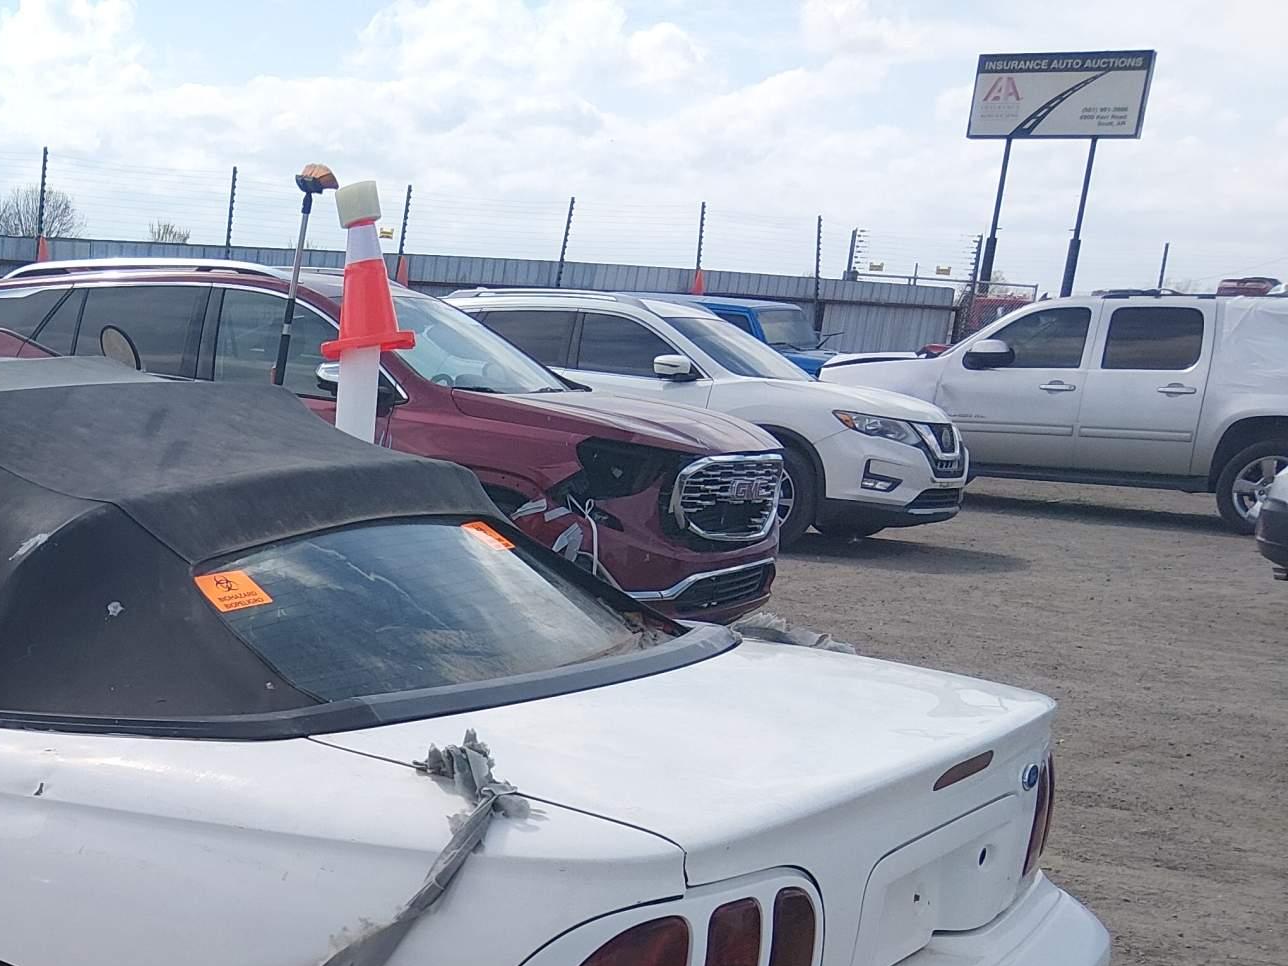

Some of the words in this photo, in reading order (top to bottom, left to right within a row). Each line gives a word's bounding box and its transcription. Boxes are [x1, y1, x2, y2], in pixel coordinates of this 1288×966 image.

[984, 59, 1049, 71] INSURANCE
[1050, 58, 1082, 69] AUTO
[1084, 56, 1145, 68] AUCTIONS
[216, 591, 258, 602] BIOHAZARD
